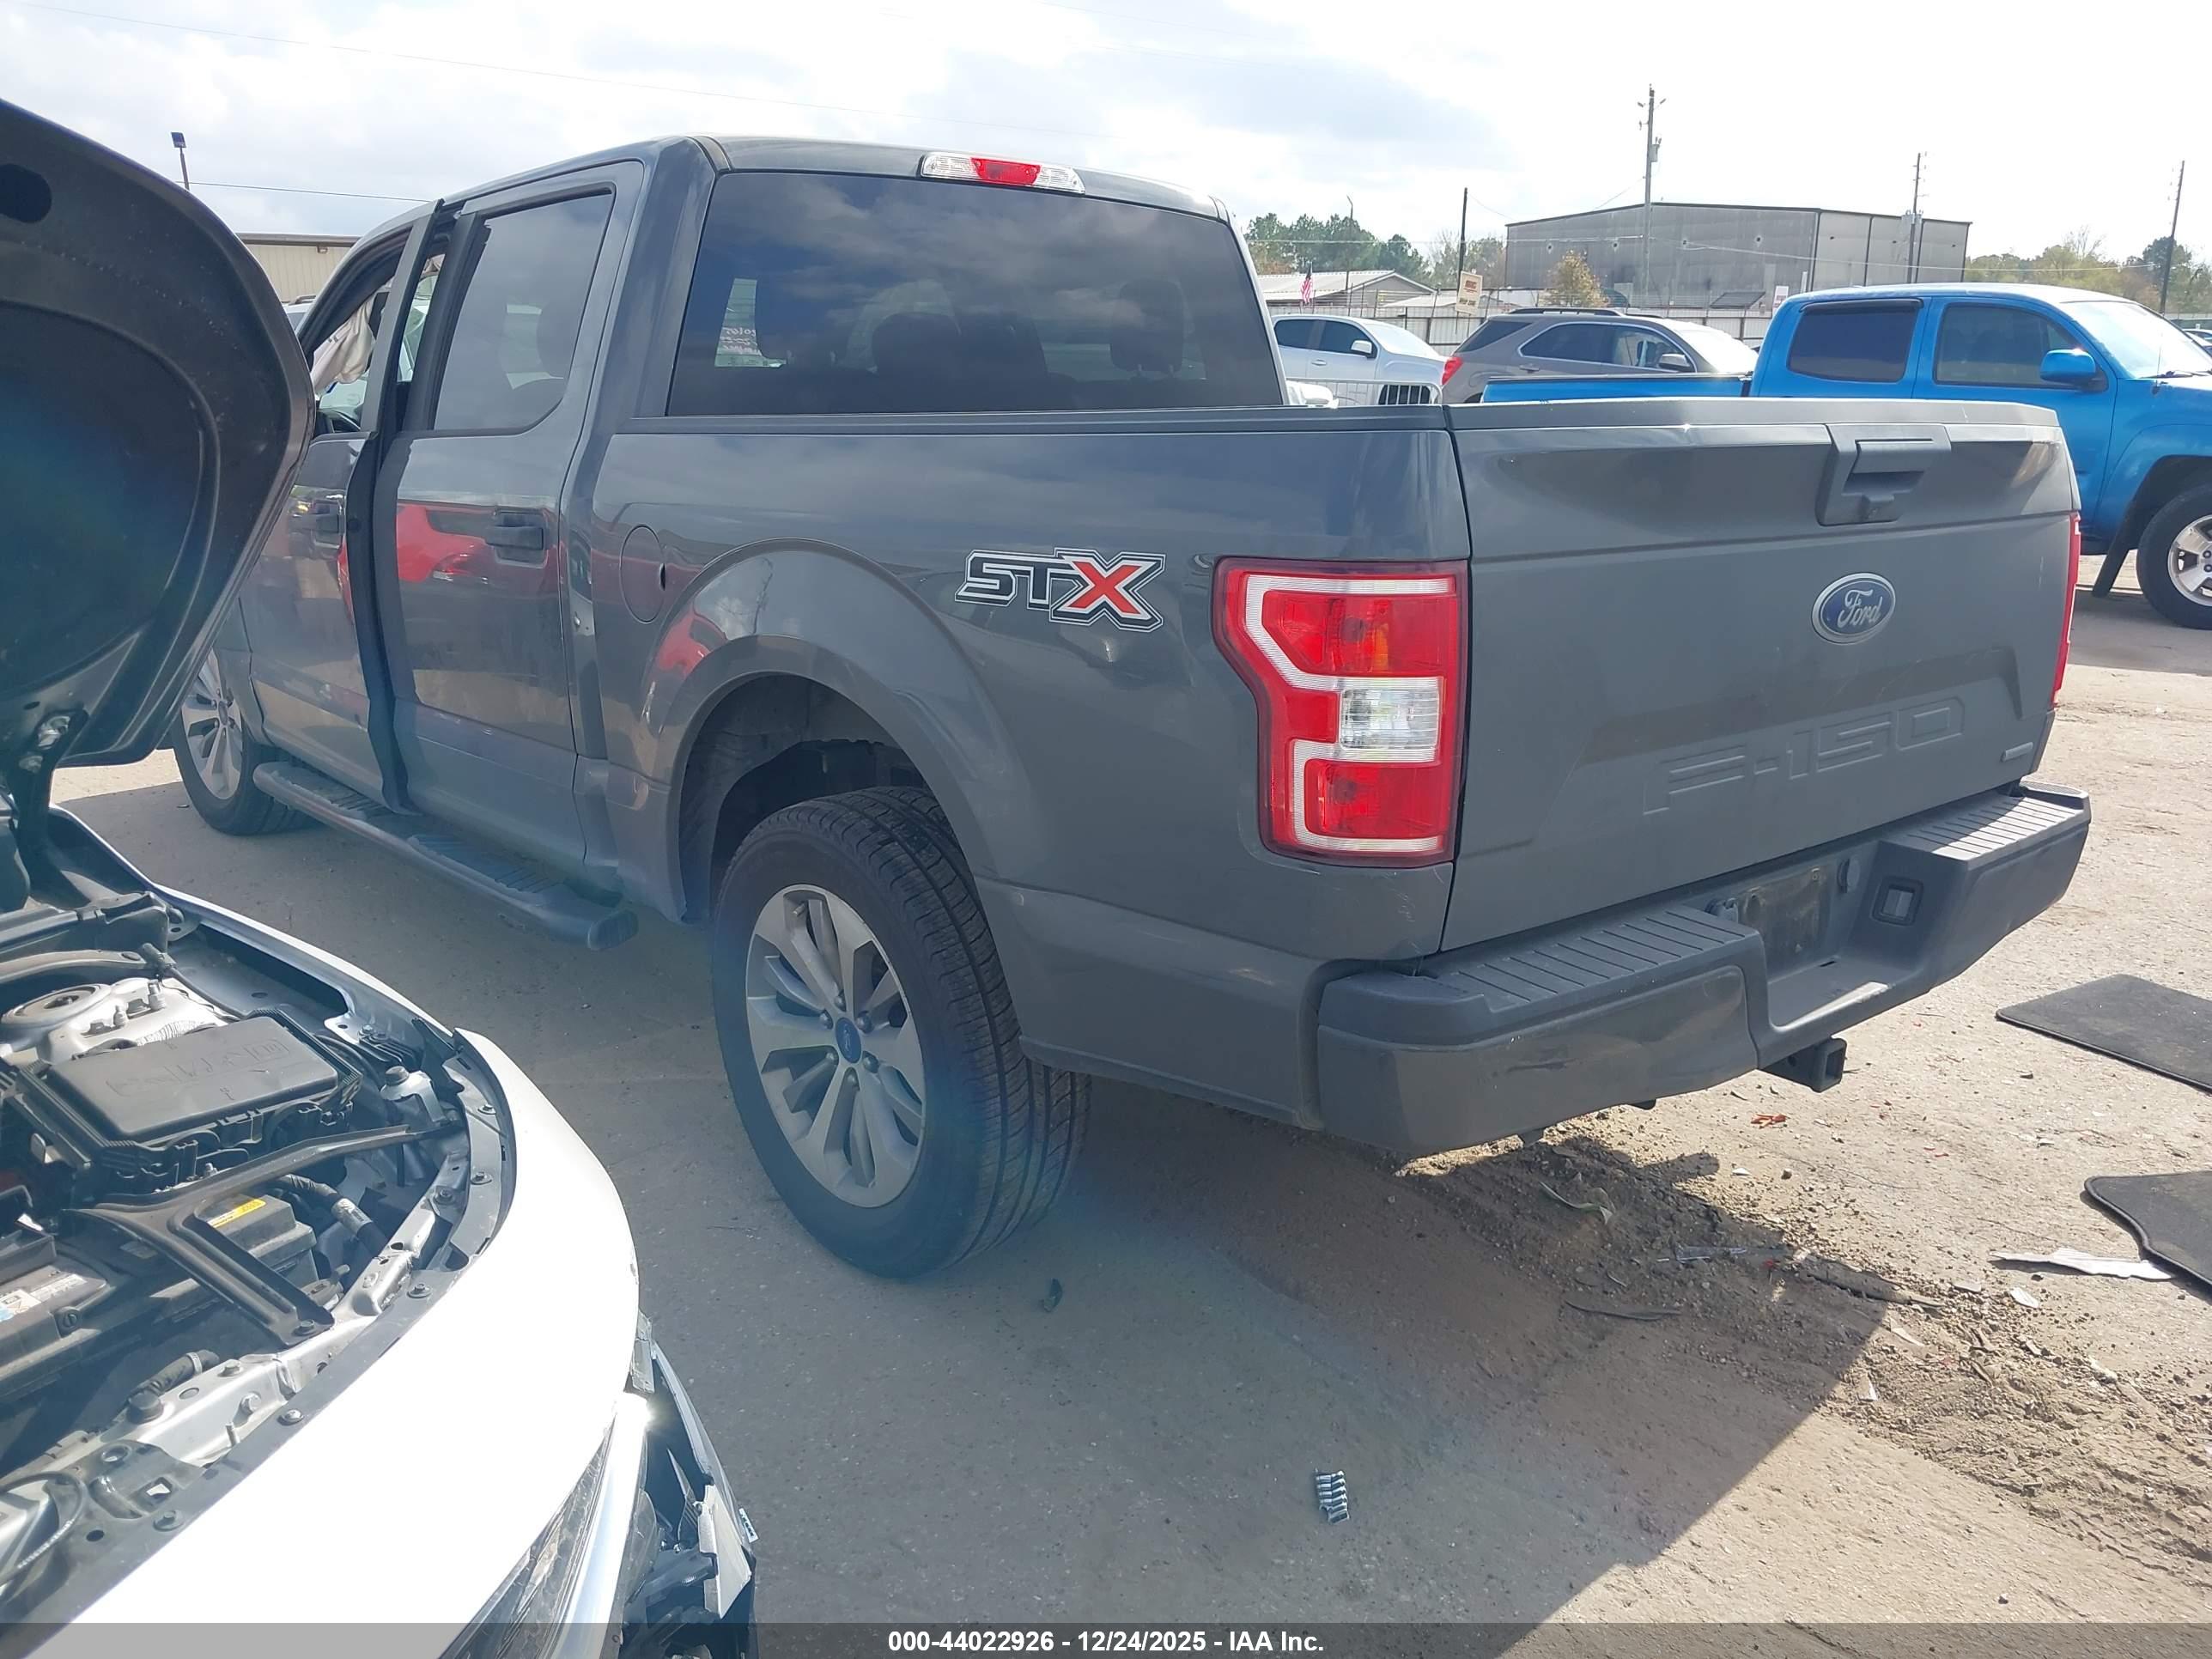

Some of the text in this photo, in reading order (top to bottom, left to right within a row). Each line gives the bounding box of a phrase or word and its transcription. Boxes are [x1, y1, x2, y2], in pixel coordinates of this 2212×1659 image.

[956, 548, 1166, 633] STX
[1837, 589, 1883, 628] Ford
[1643, 696, 1965, 815] F-150
